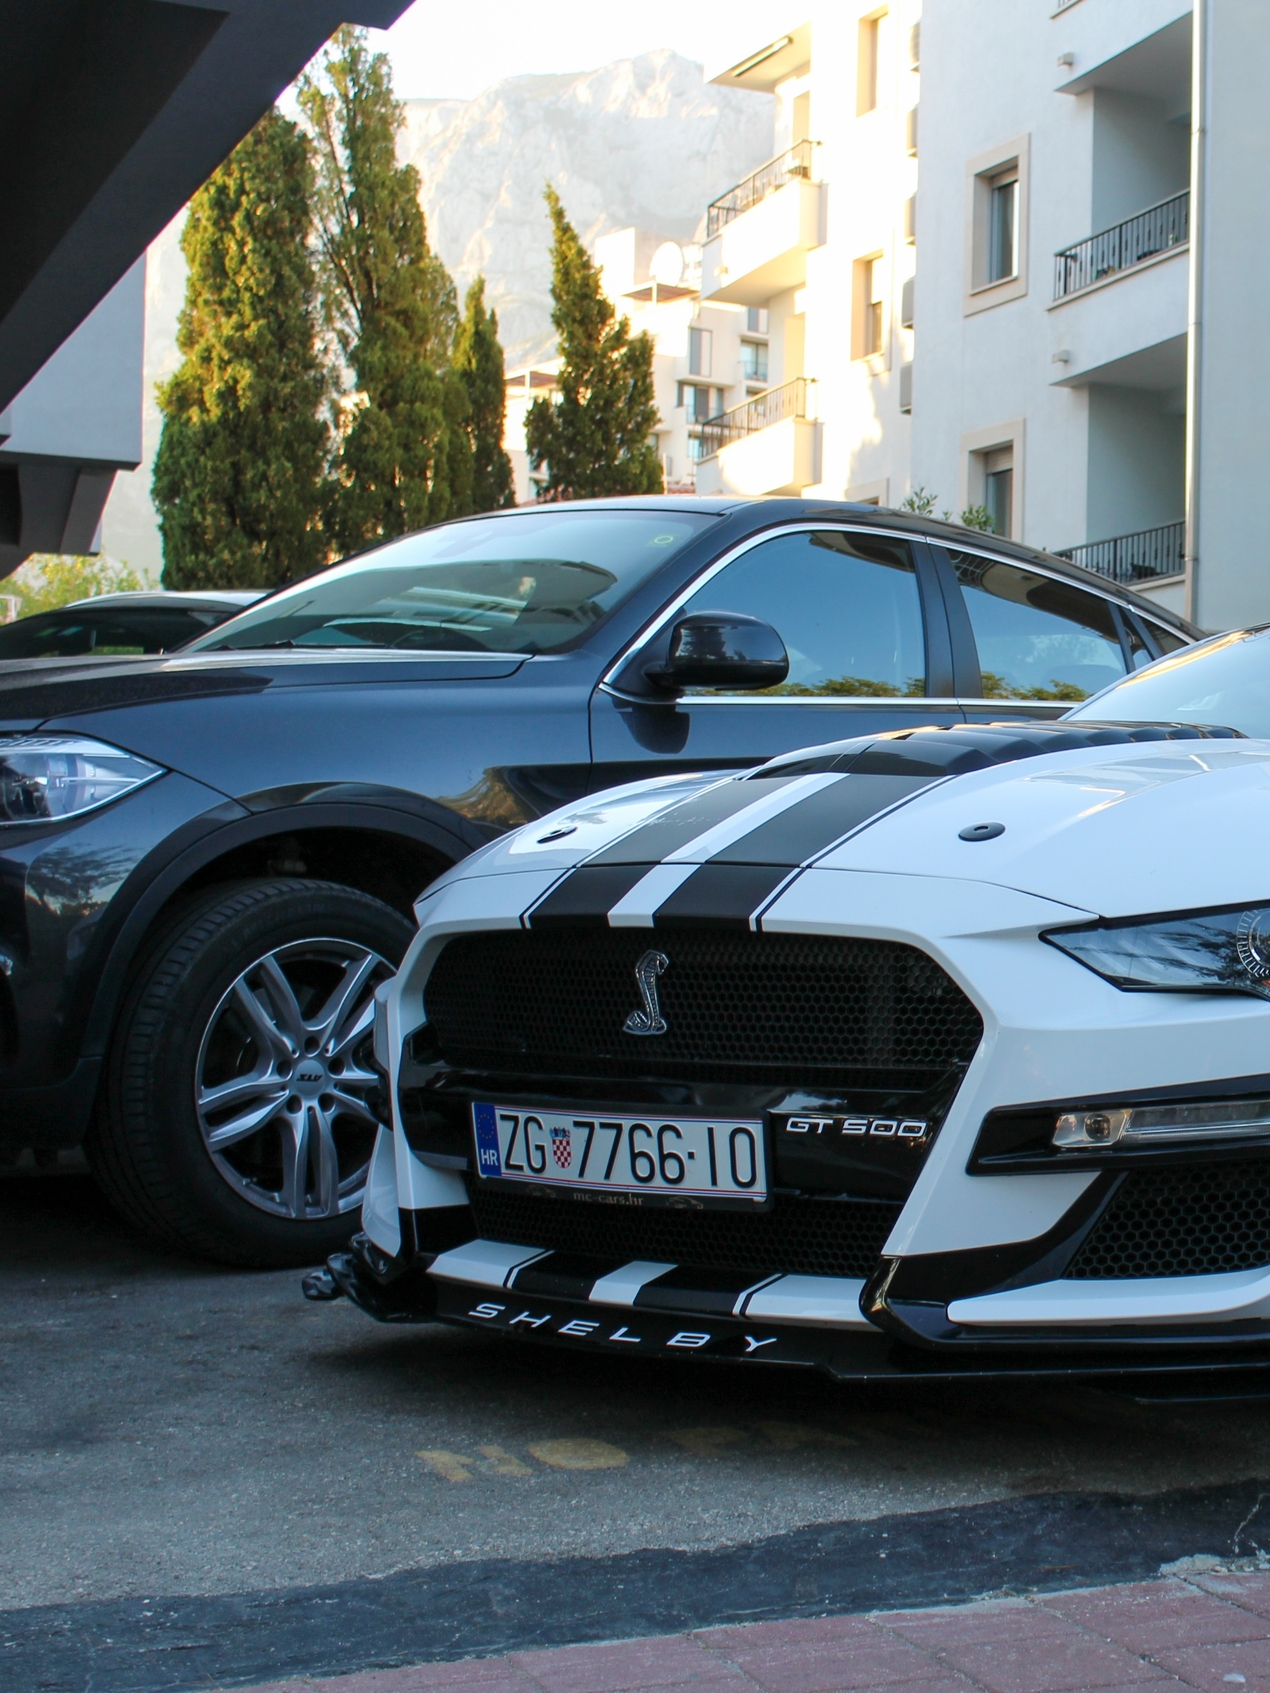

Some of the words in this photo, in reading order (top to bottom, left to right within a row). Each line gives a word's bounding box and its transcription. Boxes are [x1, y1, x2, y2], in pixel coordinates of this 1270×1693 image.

[480, 1148, 499, 1166] HR
[499, 1113, 547, 1174] ZG
[785, 1116, 835, 1135] GT
[839, 1118, 928, 1138] 500
[573, 1191, 644, 1207] mc-cars.hr
[467, 1302, 778, 1352] SHELBY
